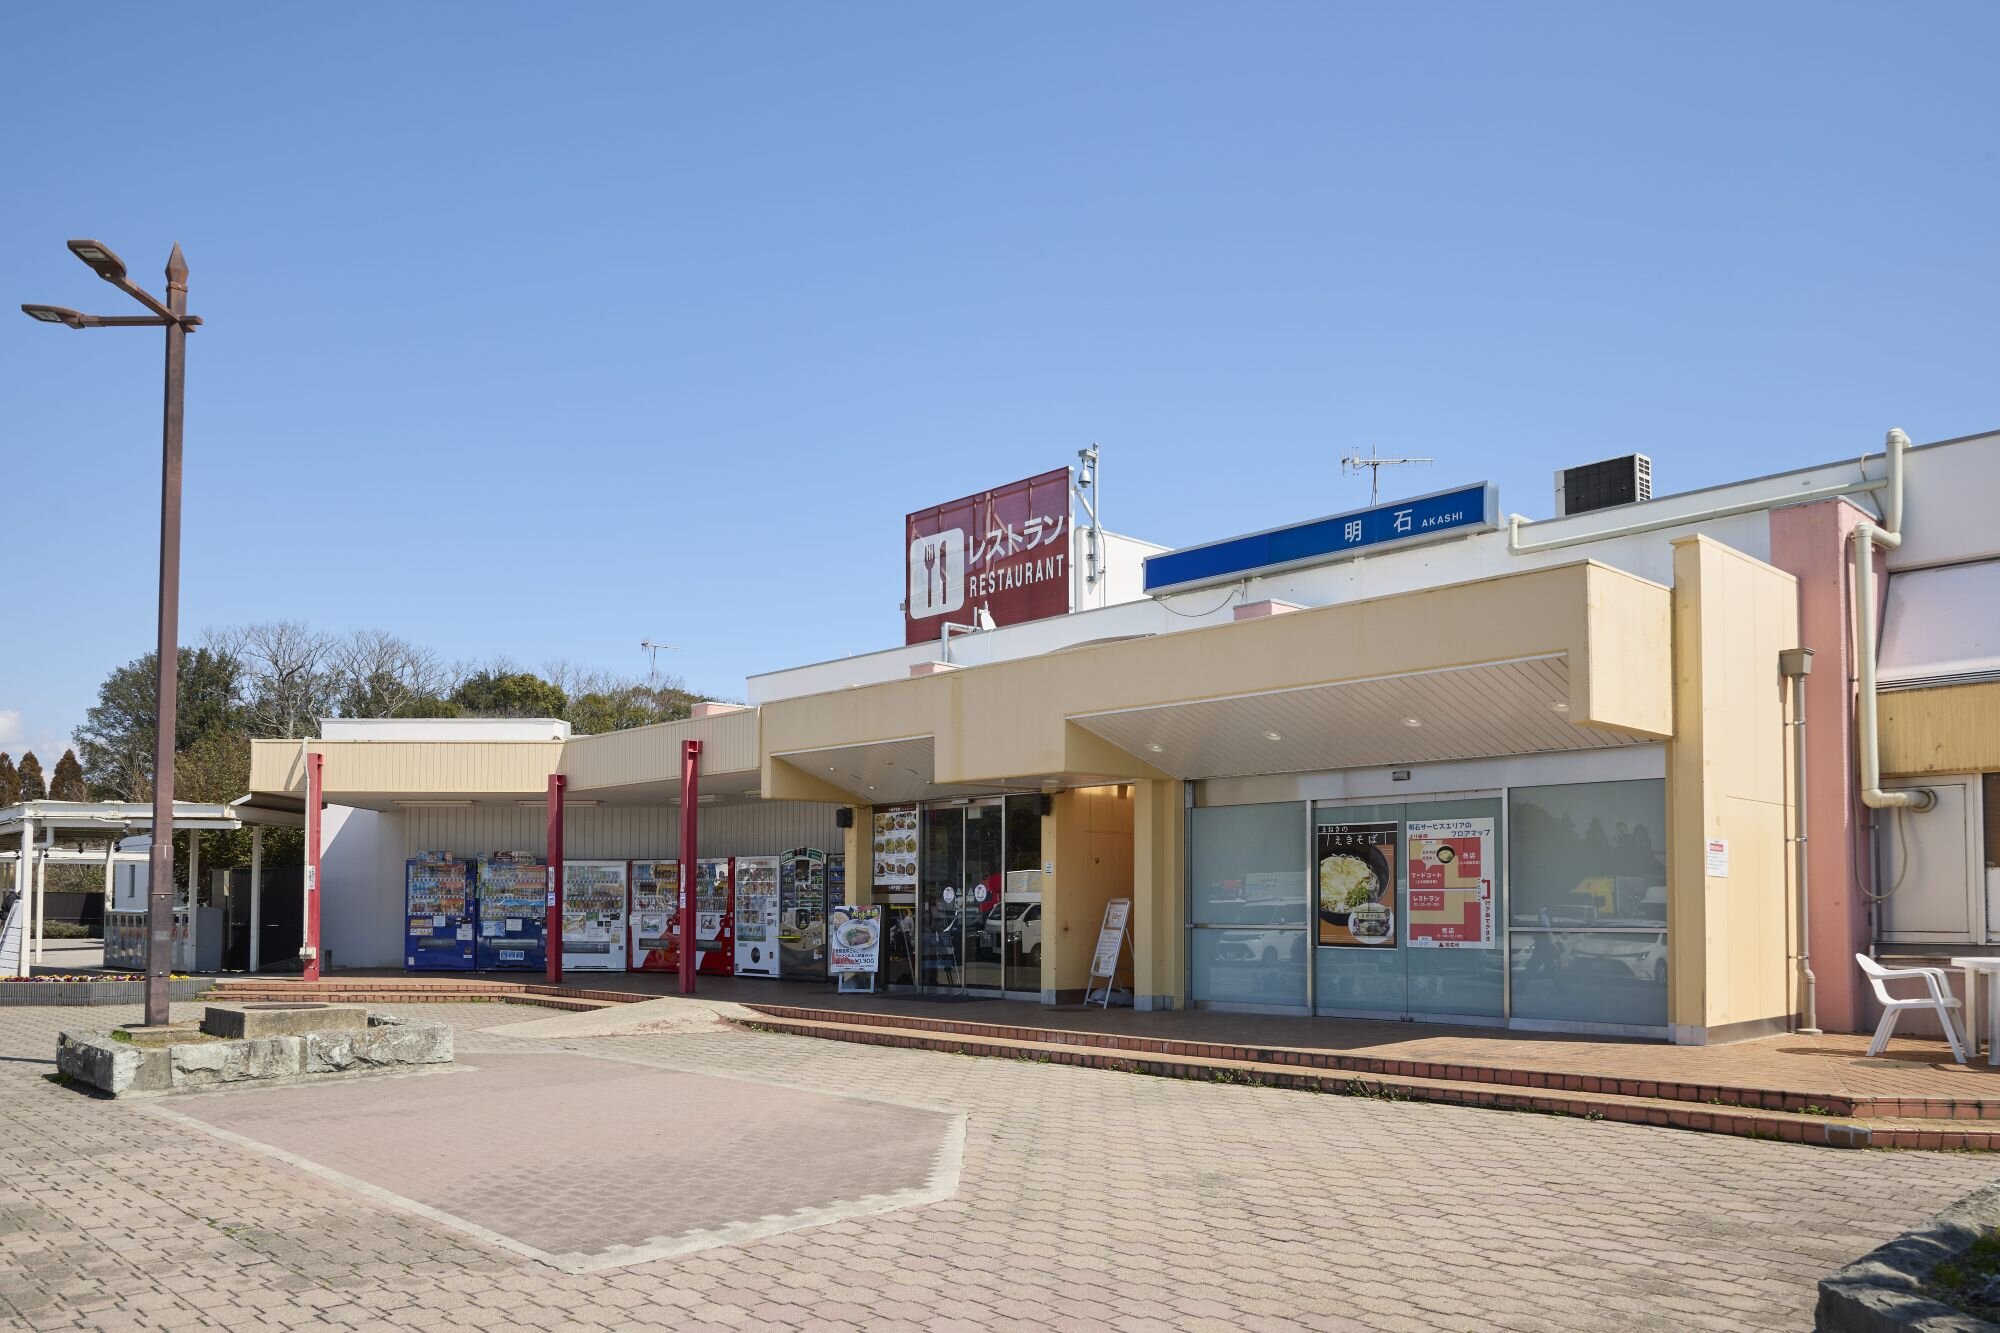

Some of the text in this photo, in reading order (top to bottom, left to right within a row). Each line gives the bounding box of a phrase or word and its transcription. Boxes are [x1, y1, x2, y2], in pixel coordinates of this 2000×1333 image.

[1421, 511, 1463, 528] AKASHI
[969, 514, 1064, 565] レストラン
[969, 554, 1065, 598] RESTAURANT
[1321, 825, 1349, 833] まねきの
[1408, 821, 1472, 831] 明石サービスエリアの
[1335, 833, 1379, 846] えきそば
[1451, 829, 1491, 838] フロアマップ
